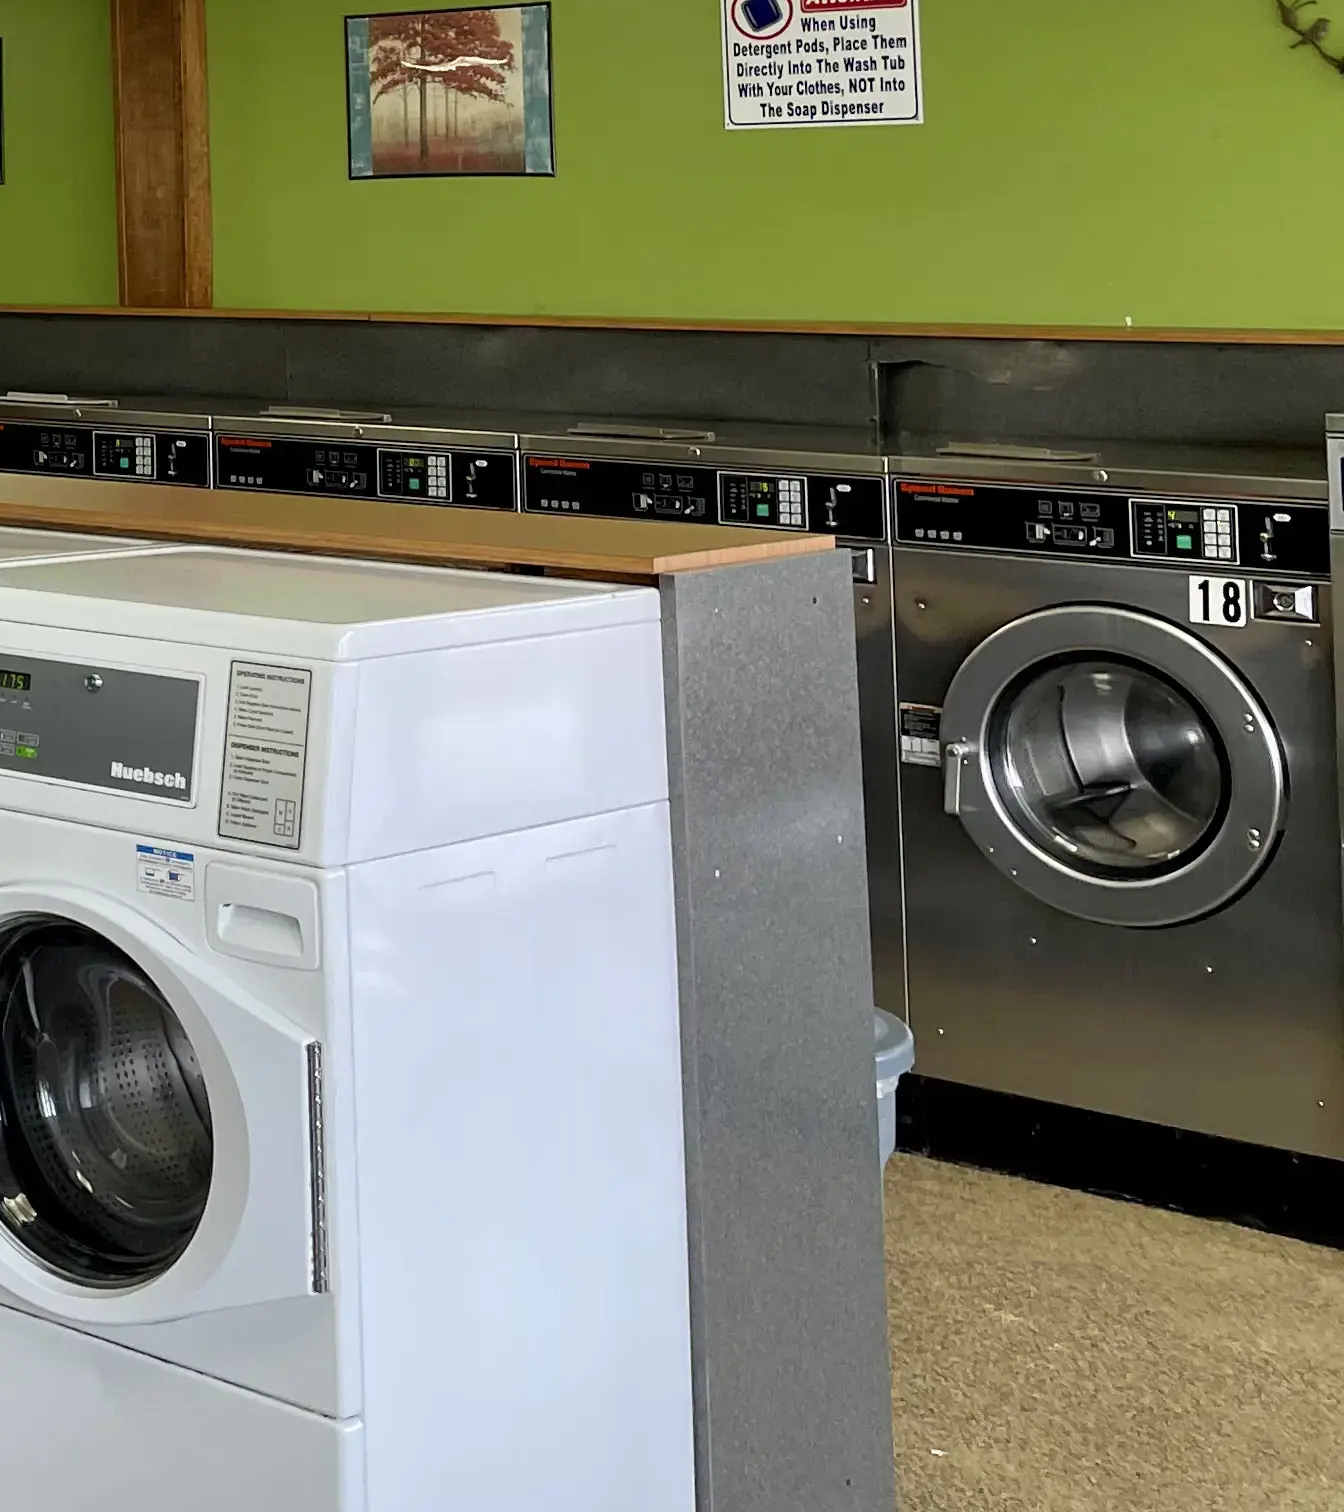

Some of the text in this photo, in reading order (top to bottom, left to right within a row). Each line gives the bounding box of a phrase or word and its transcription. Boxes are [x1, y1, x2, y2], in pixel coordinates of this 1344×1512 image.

[801, 15, 876, 33] When Using
[733, 35, 907, 59] Detergent Pods, Place Them
[737, 55, 905, 79] Directly Into The Wash Tub
[738, 77, 906, 98] With Your Clothes, NOT Into
[760, 100, 884, 119] The Soap Dispenser
[1198, 580, 1241, 623] 18
[111, 761, 186, 789] Huebsch
